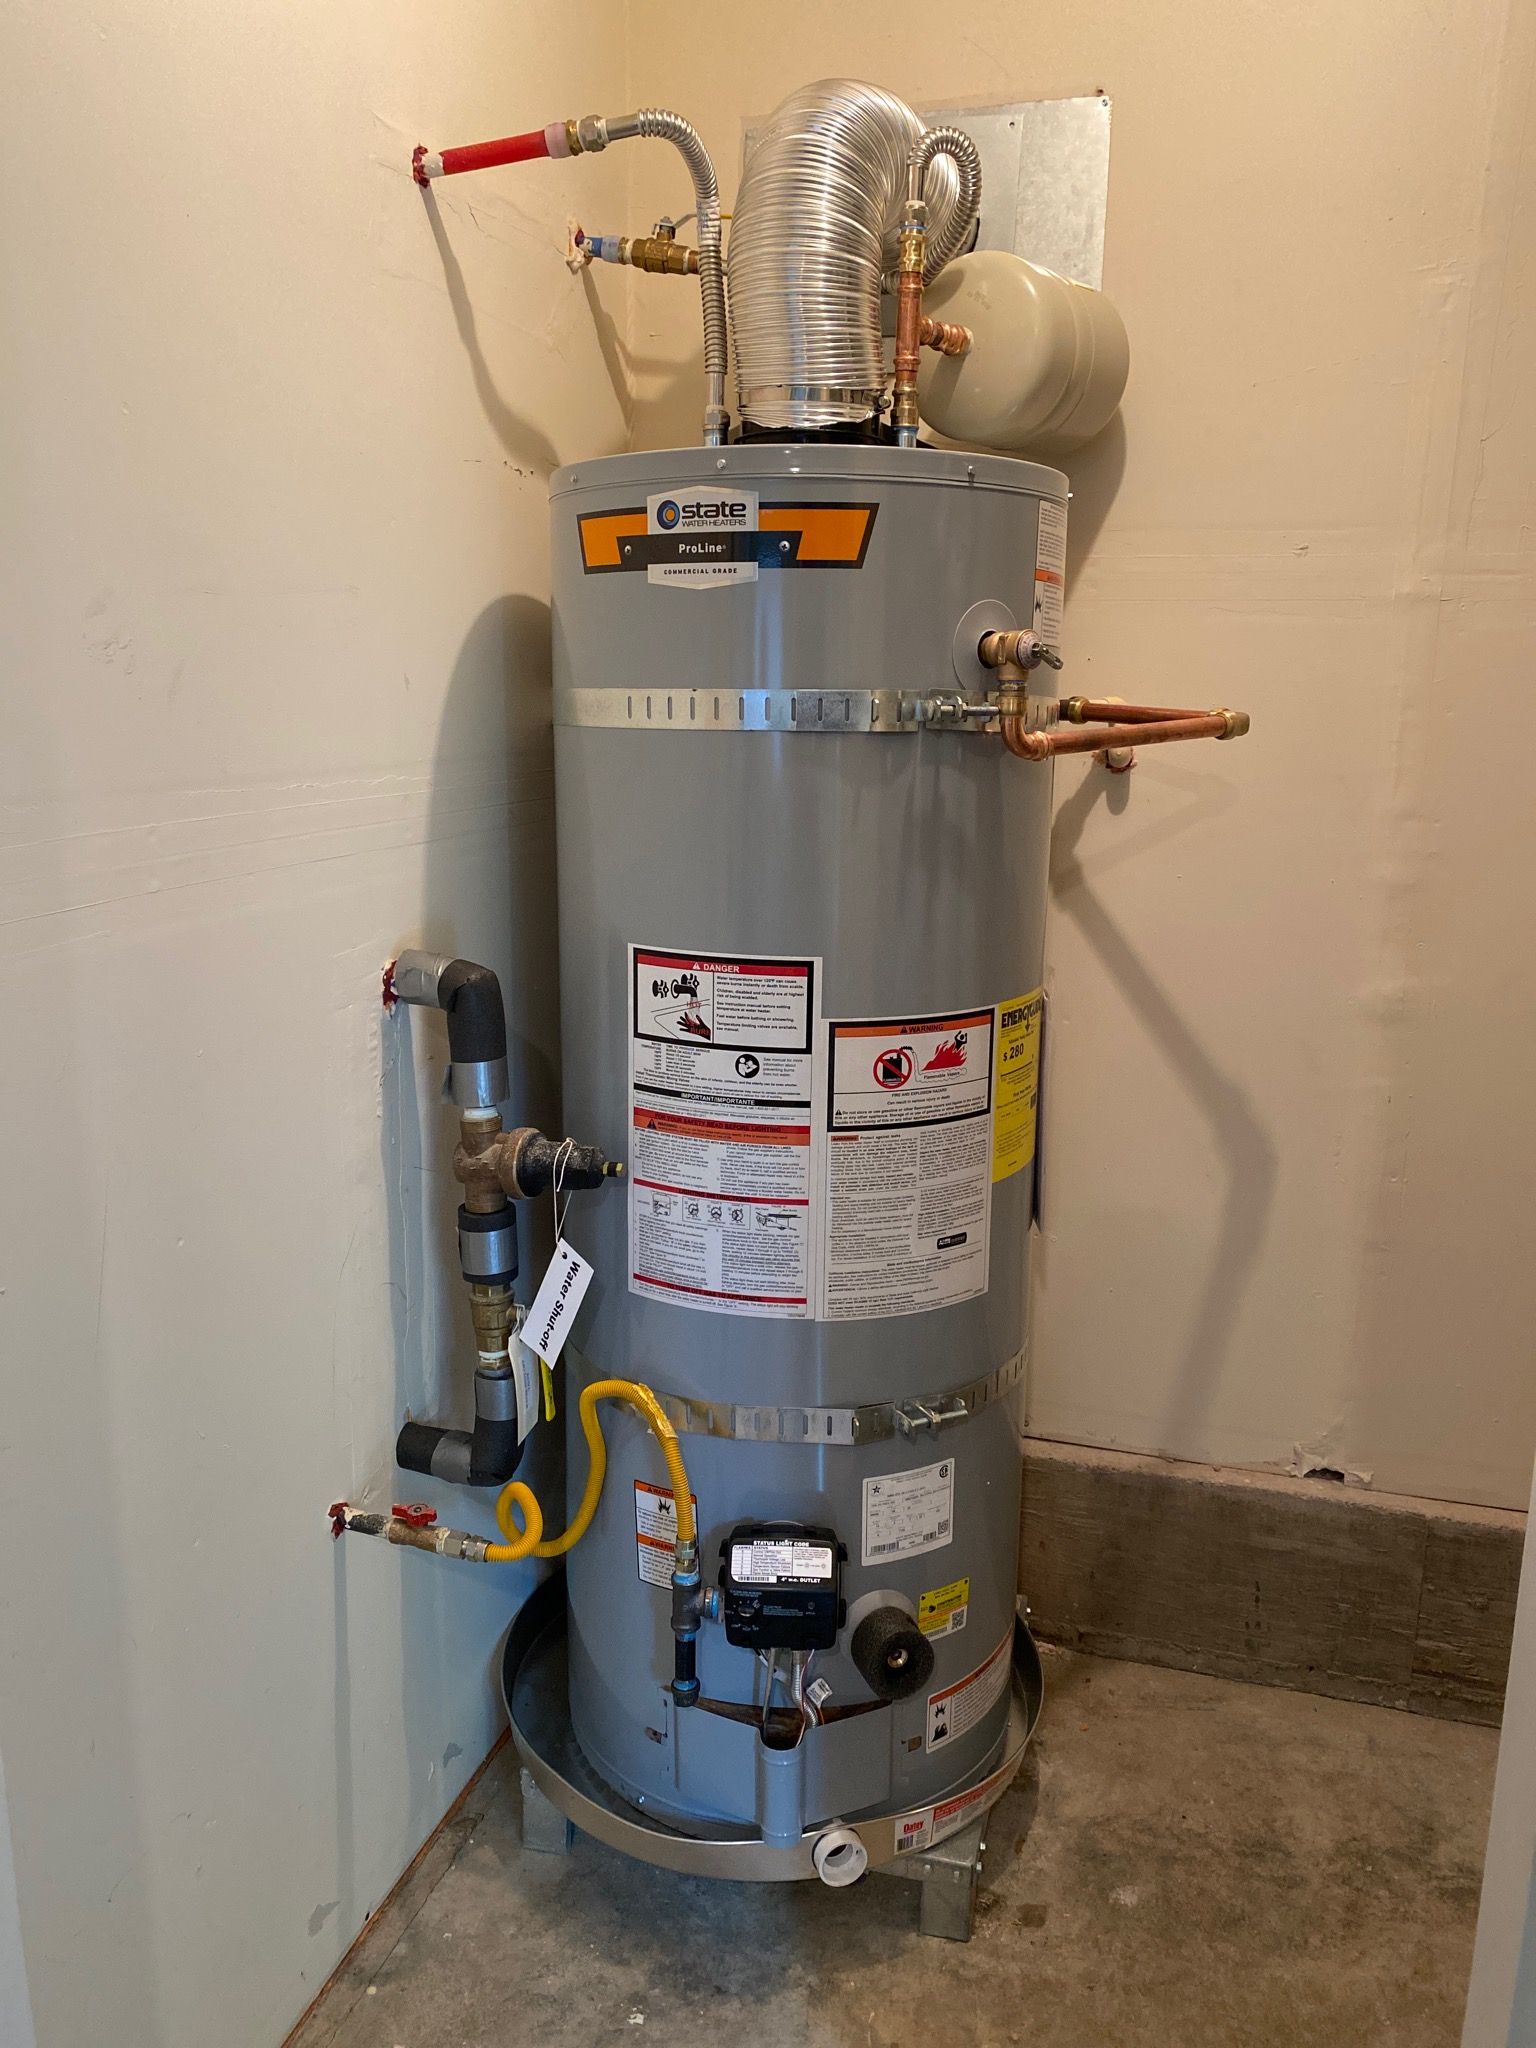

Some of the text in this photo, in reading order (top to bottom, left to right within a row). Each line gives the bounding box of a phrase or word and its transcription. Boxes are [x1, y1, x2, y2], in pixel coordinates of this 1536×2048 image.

[682, 502, 746, 519] state
[704, 964, 740, 973] DANGER
[909, 1024, 943, 1032] WARNING
[1010, 1043, 1024, 1059] 280
[560, 1261, 580, 1299] Water
[539, 1300, 564, 1351] Shut-off
